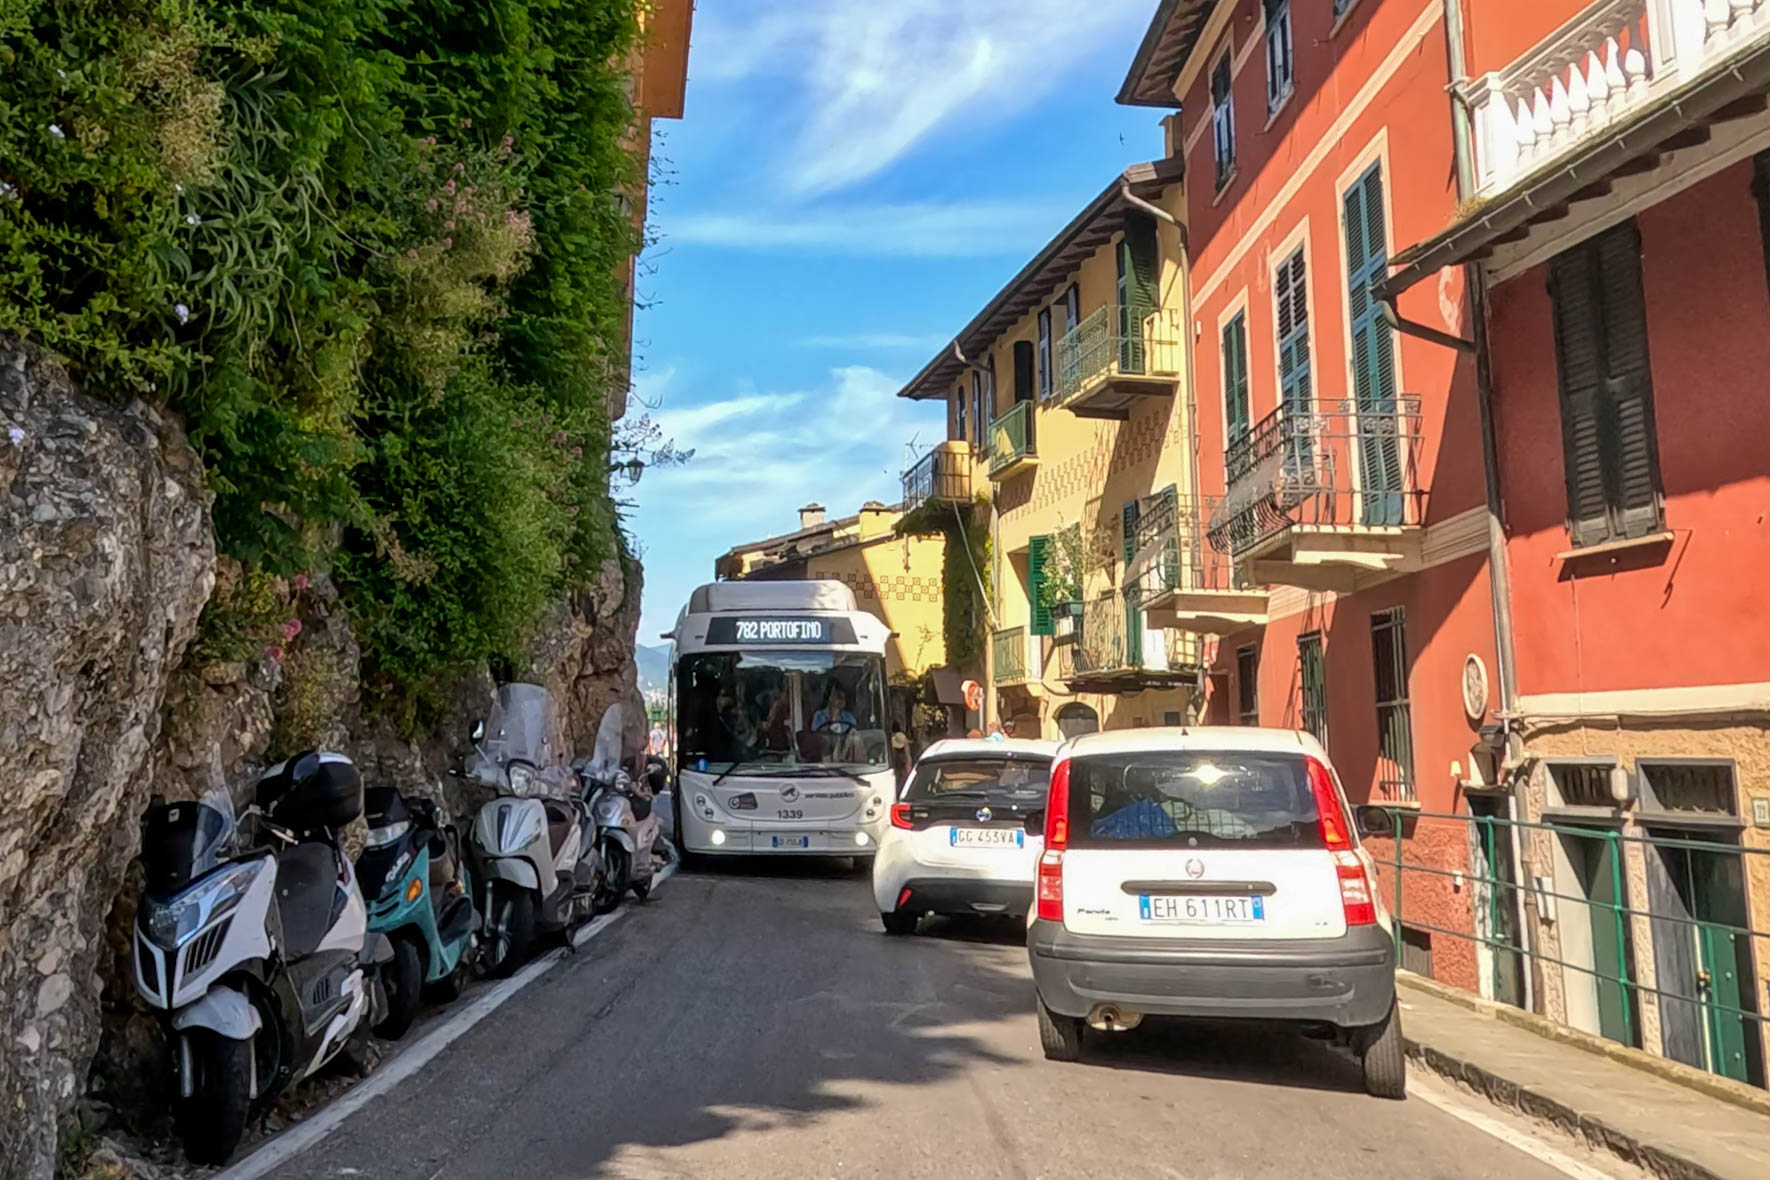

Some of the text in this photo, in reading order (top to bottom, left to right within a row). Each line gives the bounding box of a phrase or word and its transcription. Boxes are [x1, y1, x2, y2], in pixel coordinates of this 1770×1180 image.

[736, 621, 821, 639] 782 PORTOFINO
[777, 810, 803, 819] 1339
[1153, 898, 1249, 919] EH 611RT
